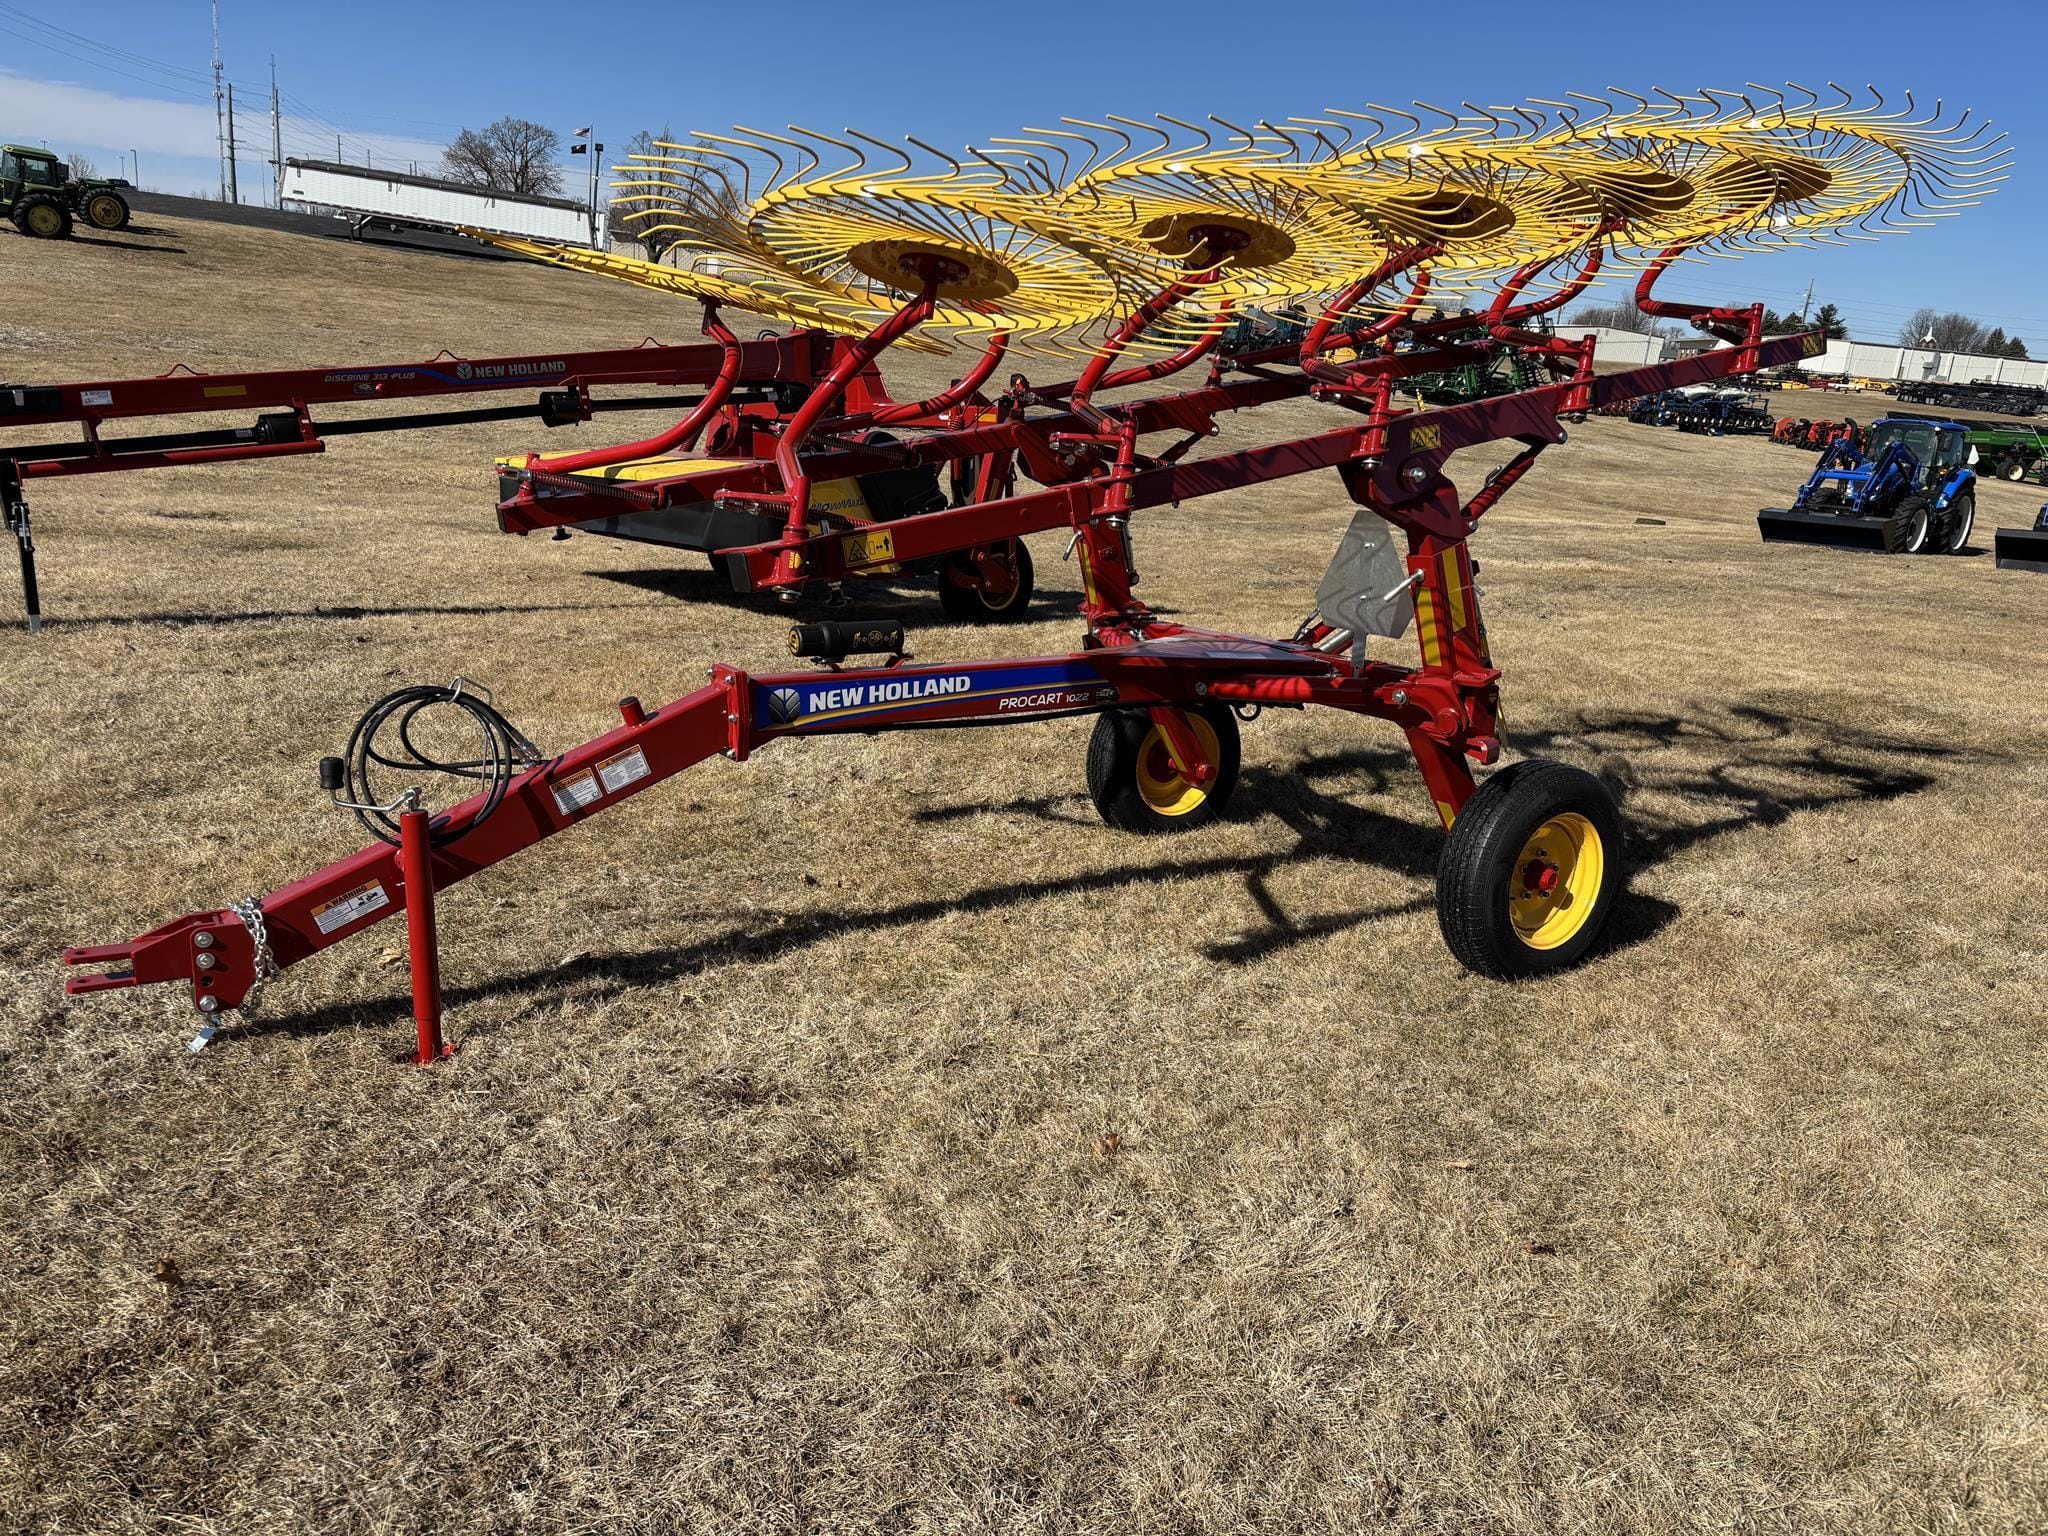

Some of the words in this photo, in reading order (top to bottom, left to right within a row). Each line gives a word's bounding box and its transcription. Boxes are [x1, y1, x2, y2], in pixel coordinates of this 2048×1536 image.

[324, 374, 370, 383] DISCBINE
[372, 373, 388, 381] 313
[475, 367, 505, 379] NEW
[510, 361, 567, 376] HOLLAND
[809, 686, 863, 712] NEW
[869, 676, 971, 703] HOLLAND
[999, 692, 1062, 710] PROCART
[1066, 692, 1089, 702] 1022
[331, 885, 368, 906] WARNING
